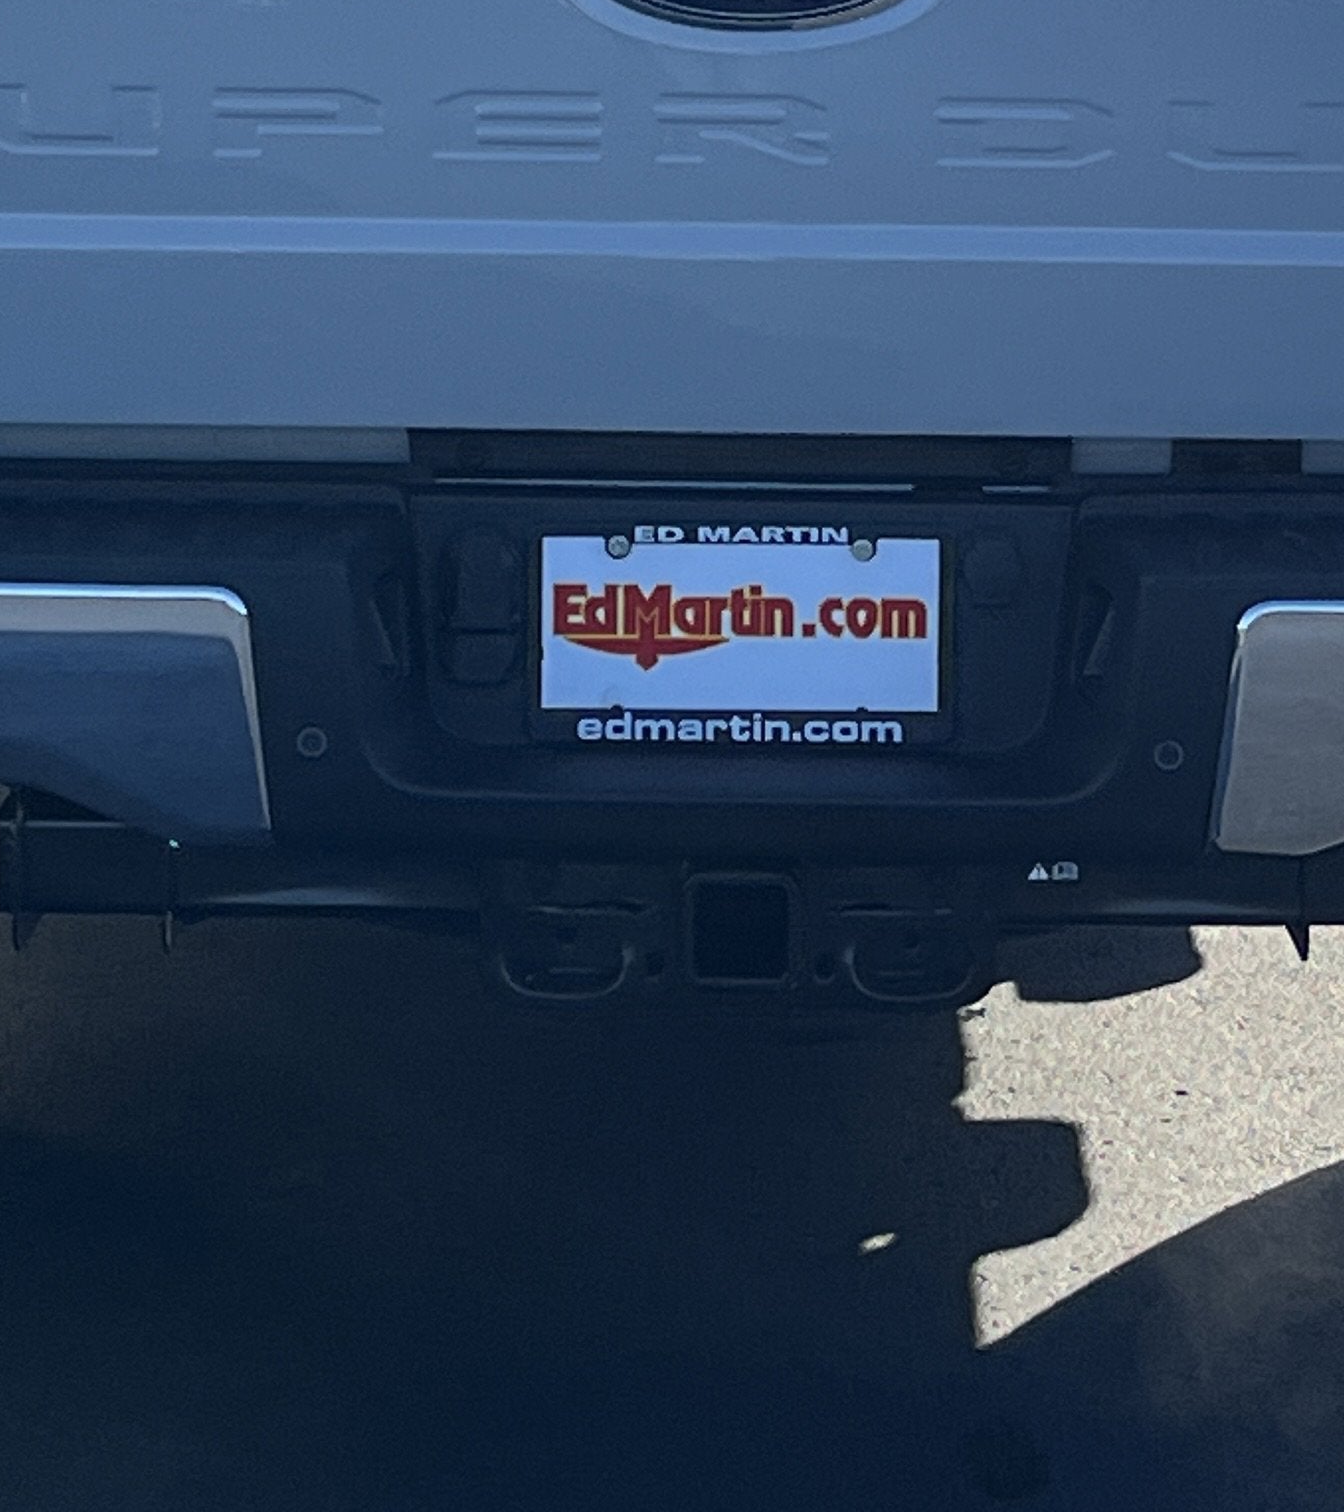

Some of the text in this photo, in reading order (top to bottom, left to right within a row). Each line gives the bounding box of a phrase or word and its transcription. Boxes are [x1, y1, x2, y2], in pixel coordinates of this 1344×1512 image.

[633, 525, 849, 544] ED MARTIN
[575, 711, 904, 744] edmartin.com
